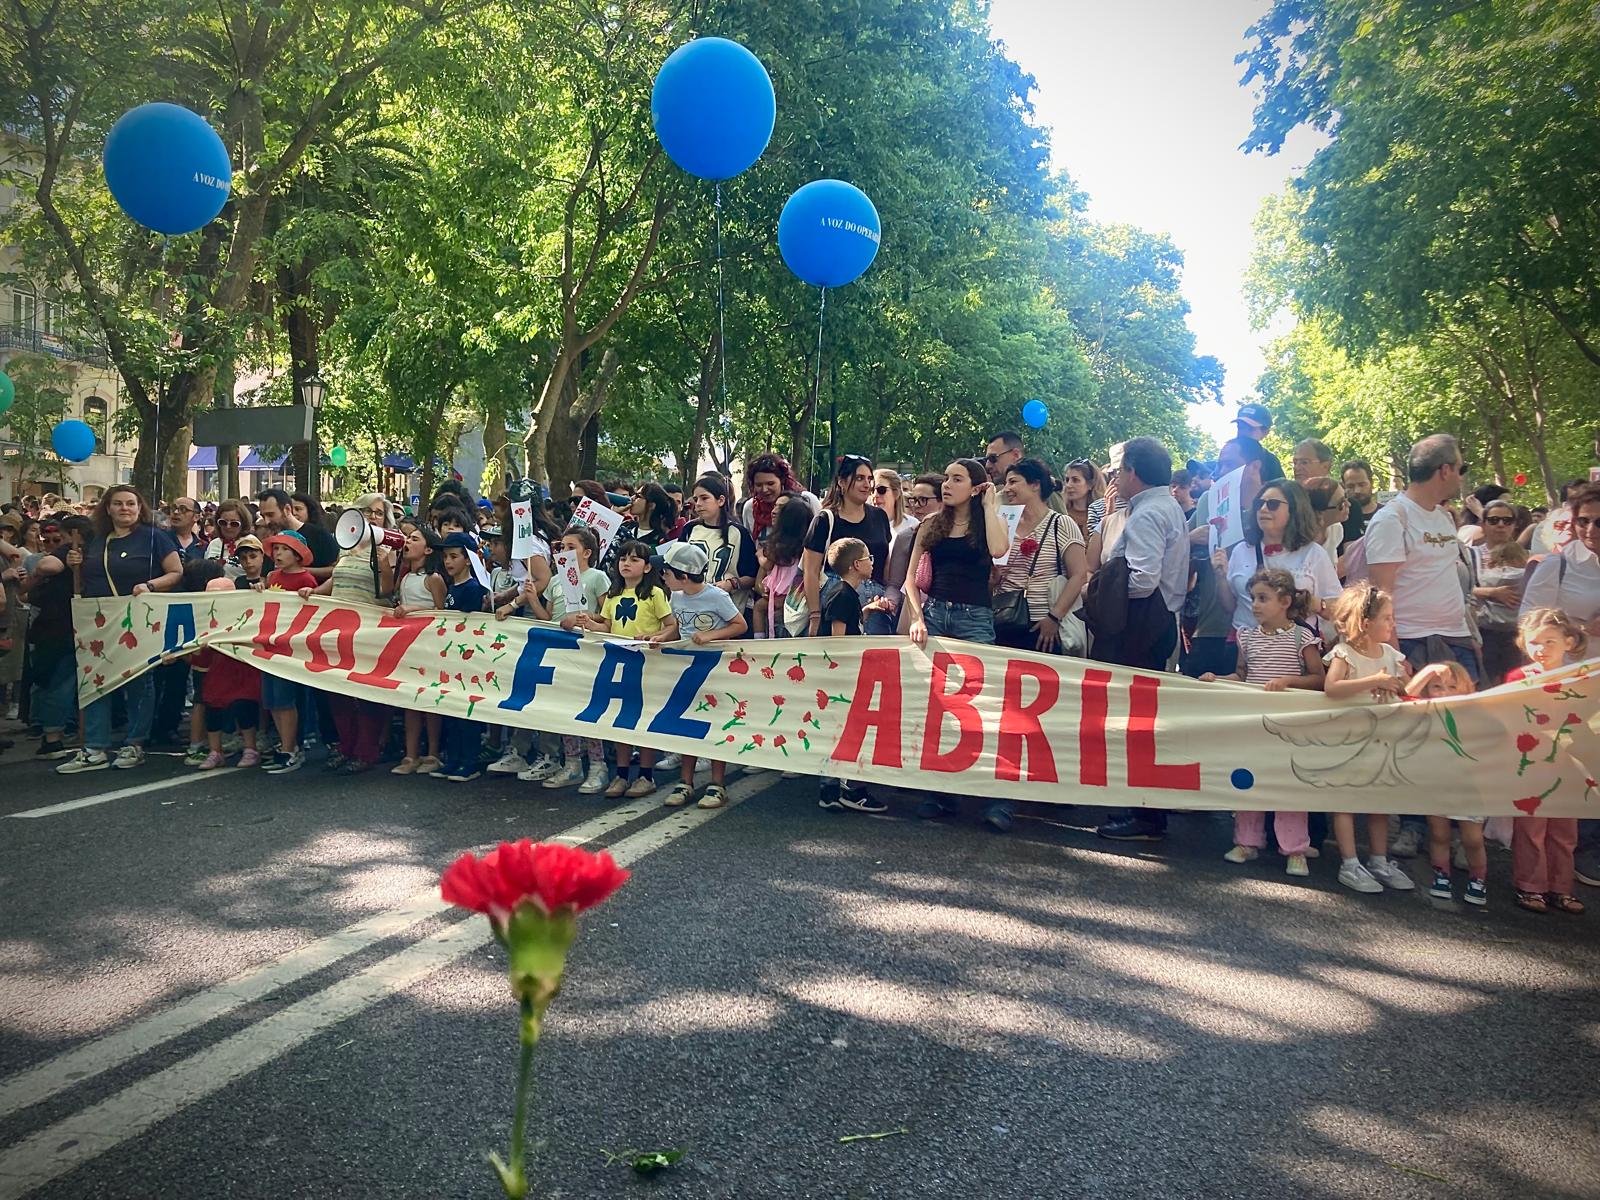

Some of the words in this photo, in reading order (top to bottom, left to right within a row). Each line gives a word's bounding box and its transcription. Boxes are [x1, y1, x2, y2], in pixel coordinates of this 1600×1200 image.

[193, 171, 199, 183] A
[200, 173, 215, 187] VOZ
[820, 217, 825, 227] A
[828, 217, 843, 228] VOZ
[845, 221, 856, 232] DO
[576, 508, 587, 519] 25
[587, 511, 598, 524] DE
[148, 603, 197, 665] A
[252, 602, 435, 689] VOZ
[498, 627, 723, 739] FAZ
